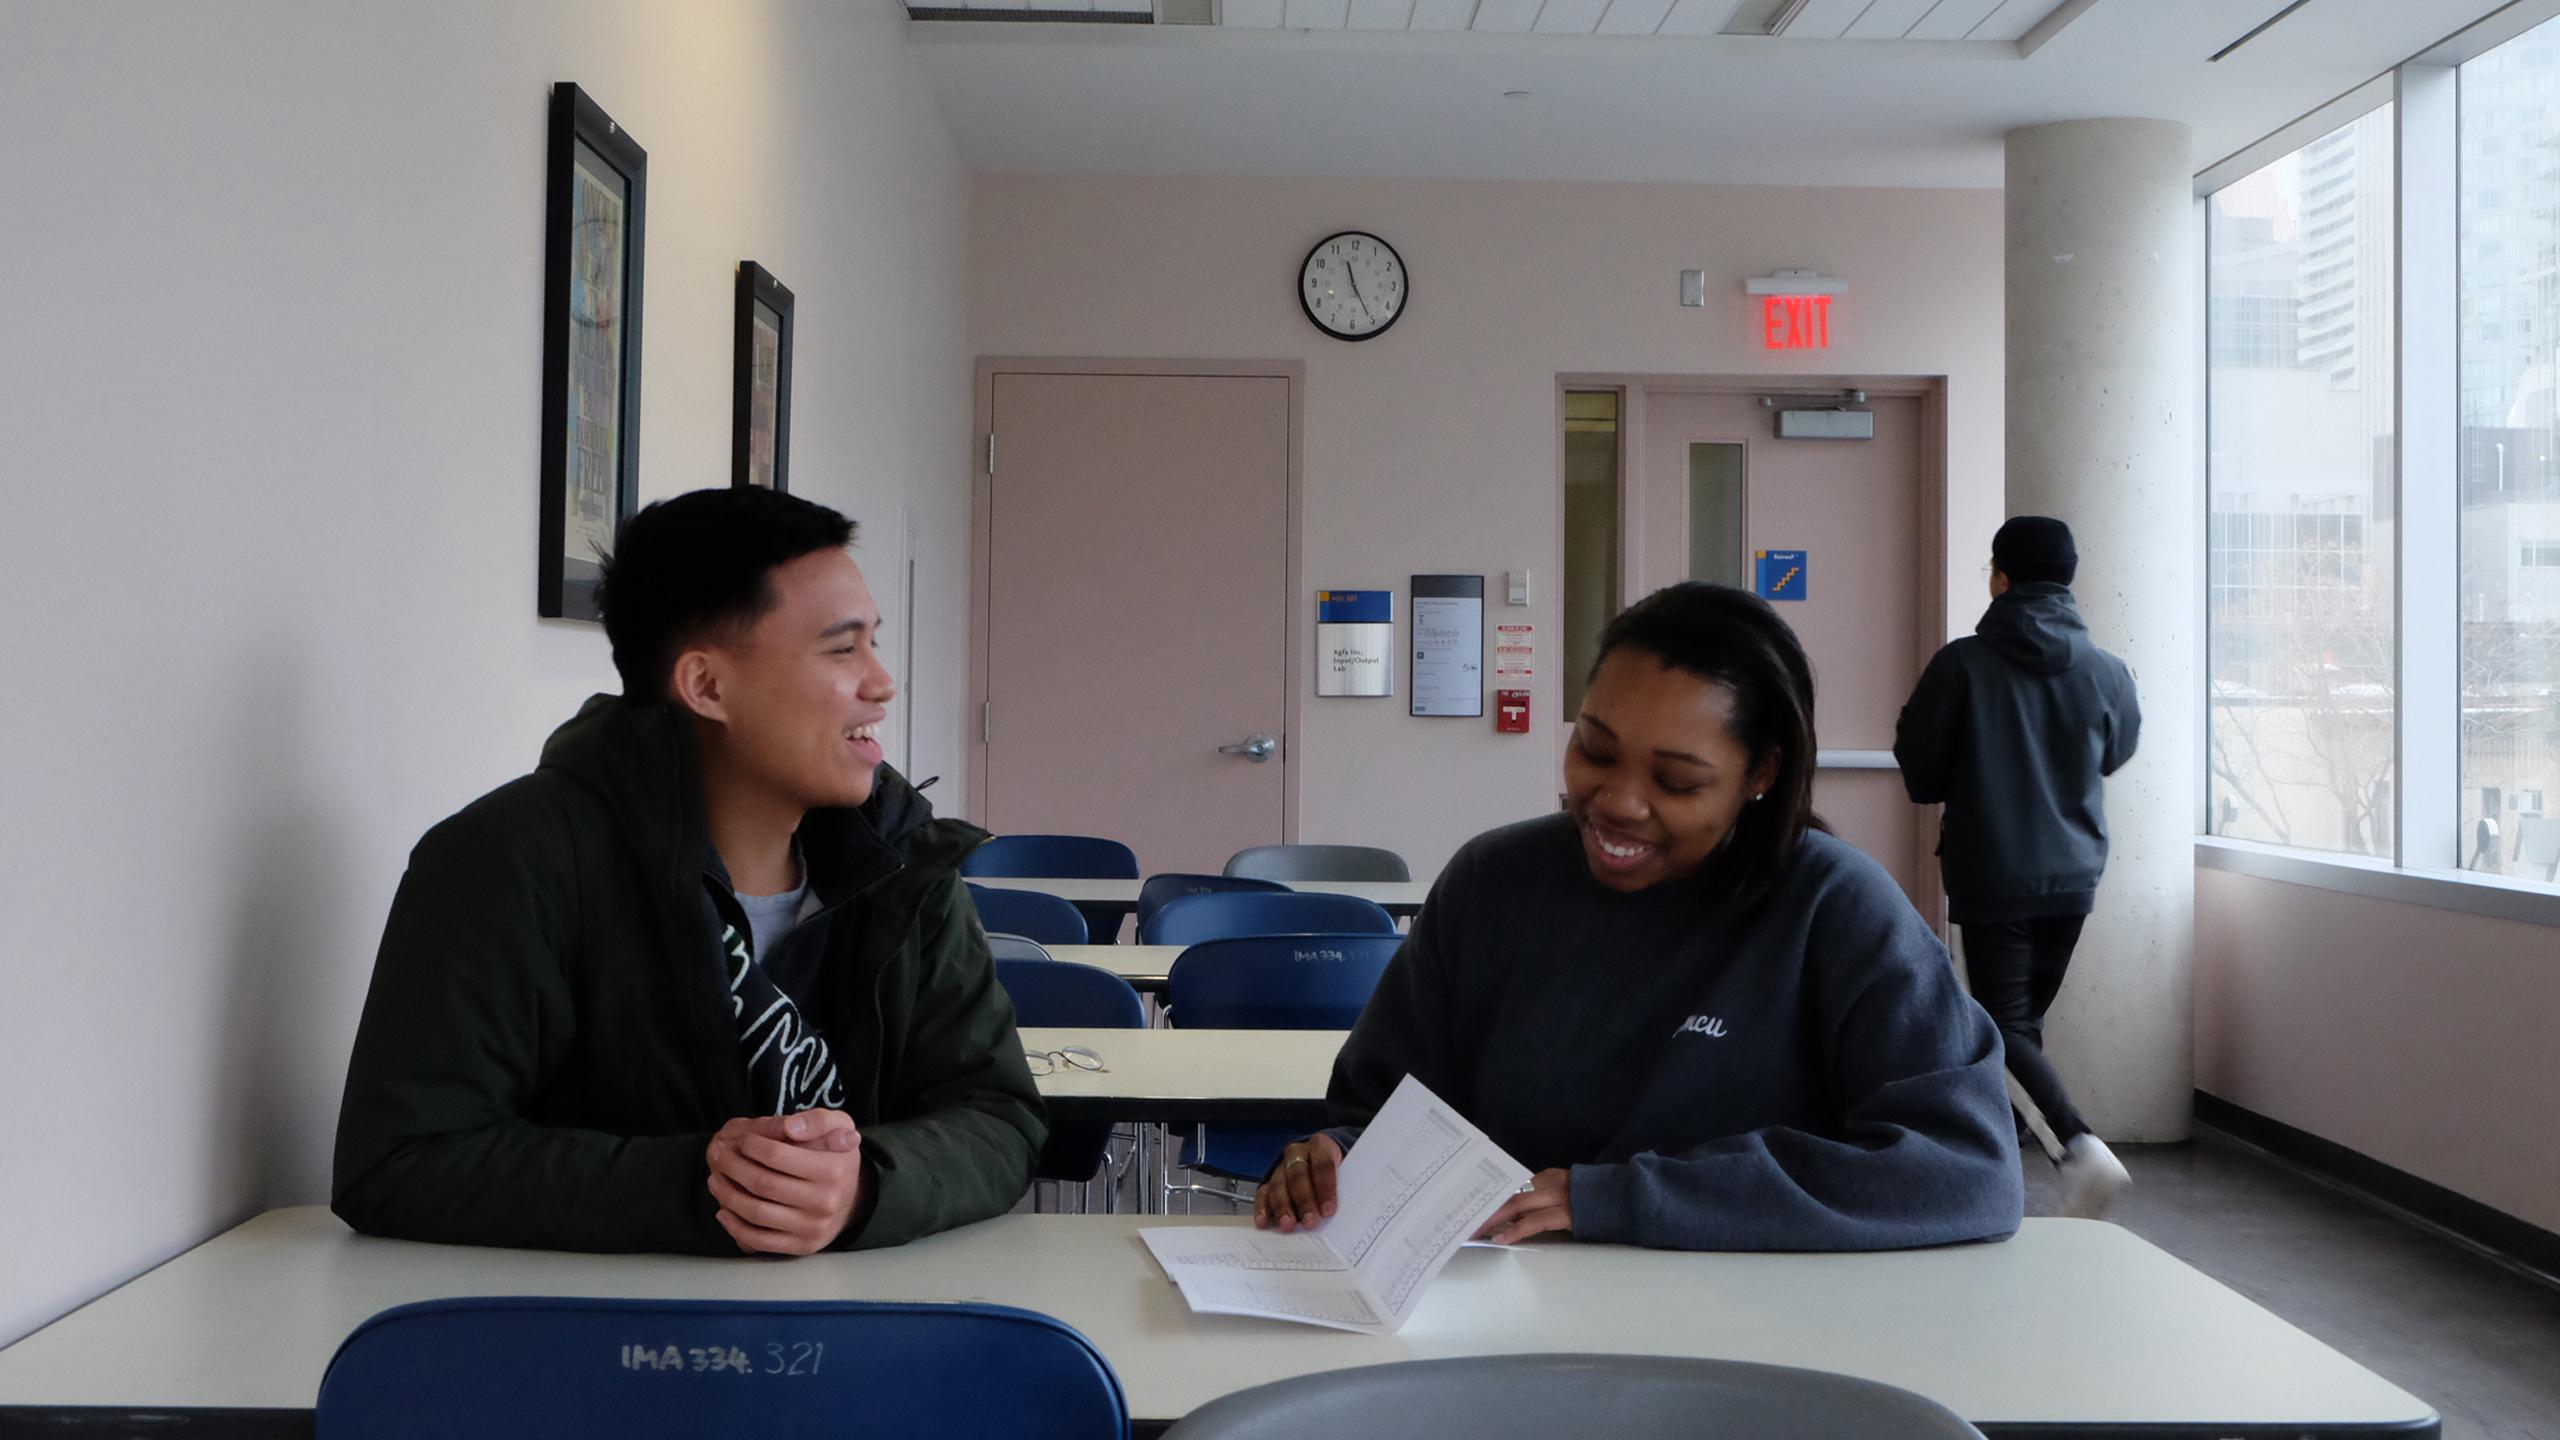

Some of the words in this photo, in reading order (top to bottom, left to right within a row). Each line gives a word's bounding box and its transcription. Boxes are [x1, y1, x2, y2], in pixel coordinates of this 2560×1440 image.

[1331, 244, 1340, 255] 11
[1351, 240, 1360, 251] 12
[1316, 258, 1325, 269] 10
[1386, 261, 1392, 272] 2
[1311, 277, 1317, 288] 9
[1391, 281, 1397, 292] 3
[1316, 298, 1321, 309] 8
[1385, 301, 1390, 311] 4
[1331, 313, 1336, 323] 7
[1369, 315, 1376, 325] 5
[1764, 295, 1832, 350] EXIT
[1349, 319, 1355, 330] 6
[1294, 950, 1319, 962] IMA
[621, 1344, 684, 1370] IMA
[765, 1342, 824, 1375] 321
